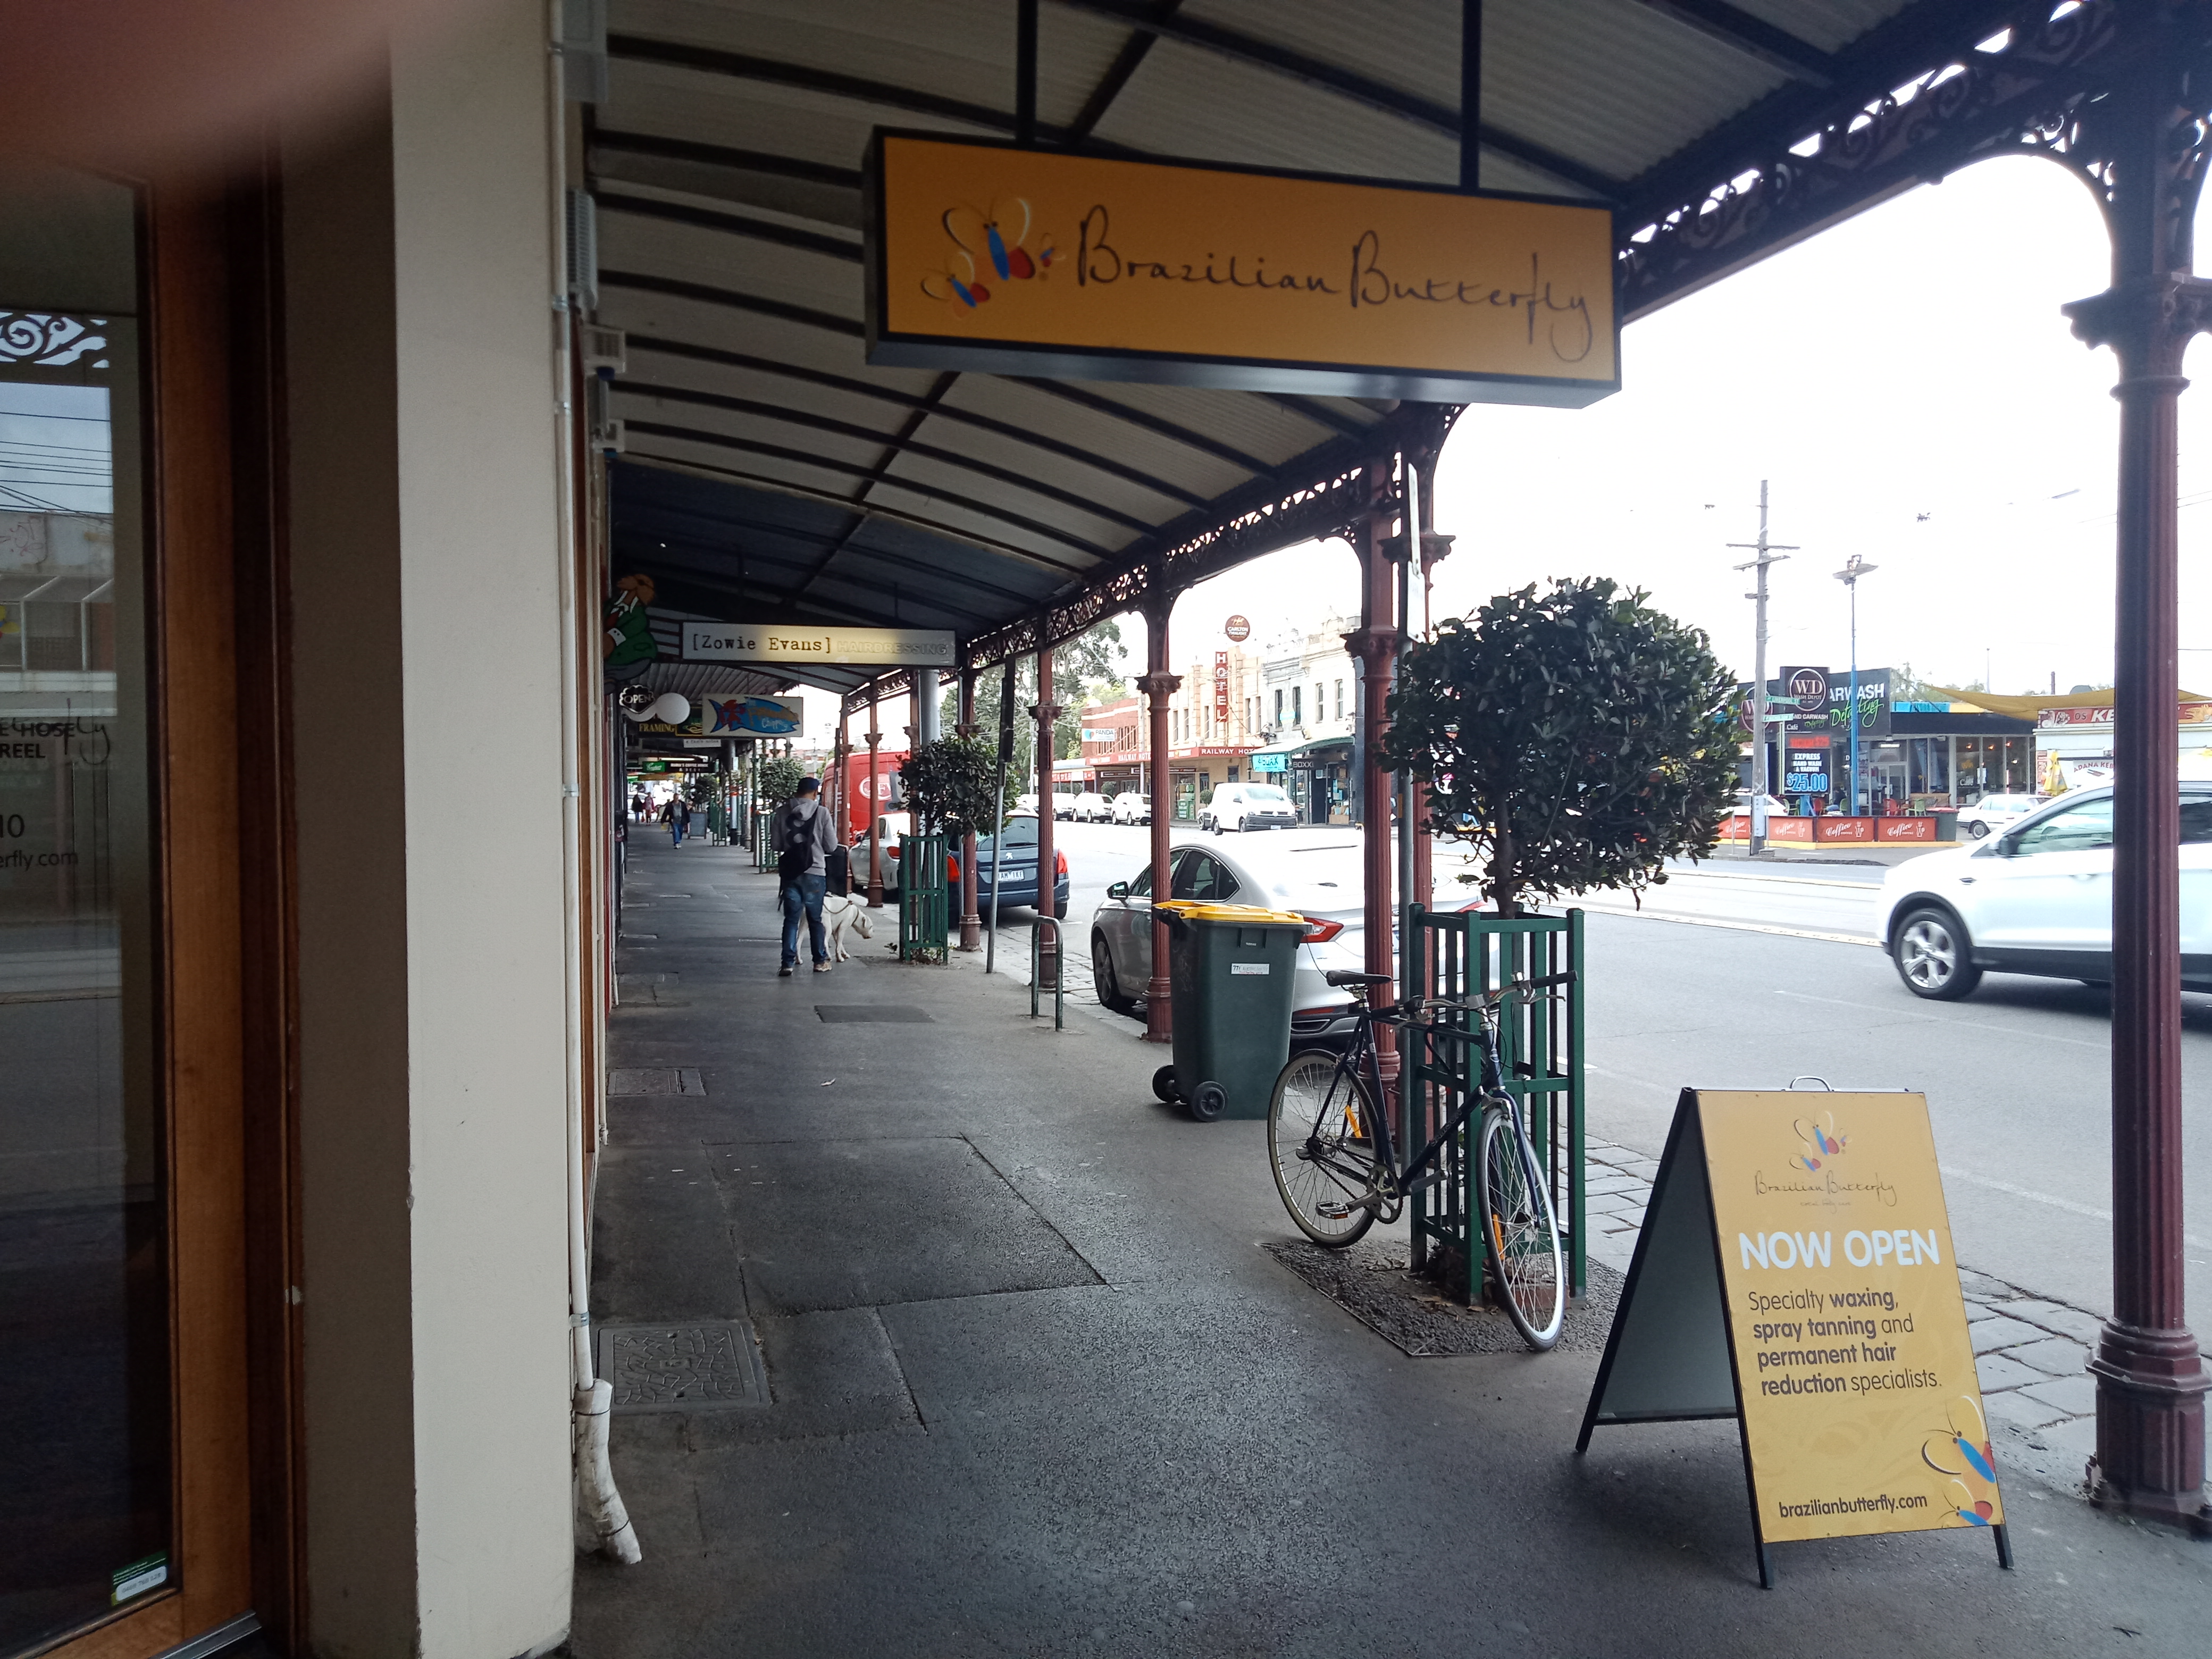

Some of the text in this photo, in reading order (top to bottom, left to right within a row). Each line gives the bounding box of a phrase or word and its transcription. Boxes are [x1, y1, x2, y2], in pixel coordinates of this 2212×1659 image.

[1078, 204, 1594, 363] Brazilian Butterfly
[692, 634, 948, 655] [Zowie Evans] HAIRDRESSING
[624, 693, 652, 704] OPEN
[1216, 652, 1227, 722] HOTEL
[1795, 679, 1823, 695] WD
[1829, 683, 1885, 702] ARWASH
[639, 723, 675, 732] FRAMING
[2075, 712, 2087, 720] OS
[1118, 753, 1137, 762] RAILWAY
[2074, 762, 2098, 773] ADANA
[1787, 772, 1828, 792] $25.00
[1755, 1170, 1897, 1207] Brazilian Butterfly
[1738, 1229, 1940, 1270] NOW OPEN
[1748, 1287, 1899, 1316] Specialty waxing,
[1753, 1312, 1915, 1344] spray tanning and
[1757, 1340, 1897, 1373] permanent hair
[1761, 1369, 1943, 1396] reduction specialists.
[1778, 1493, 1928, 1519] brazilianbutterfly.com
